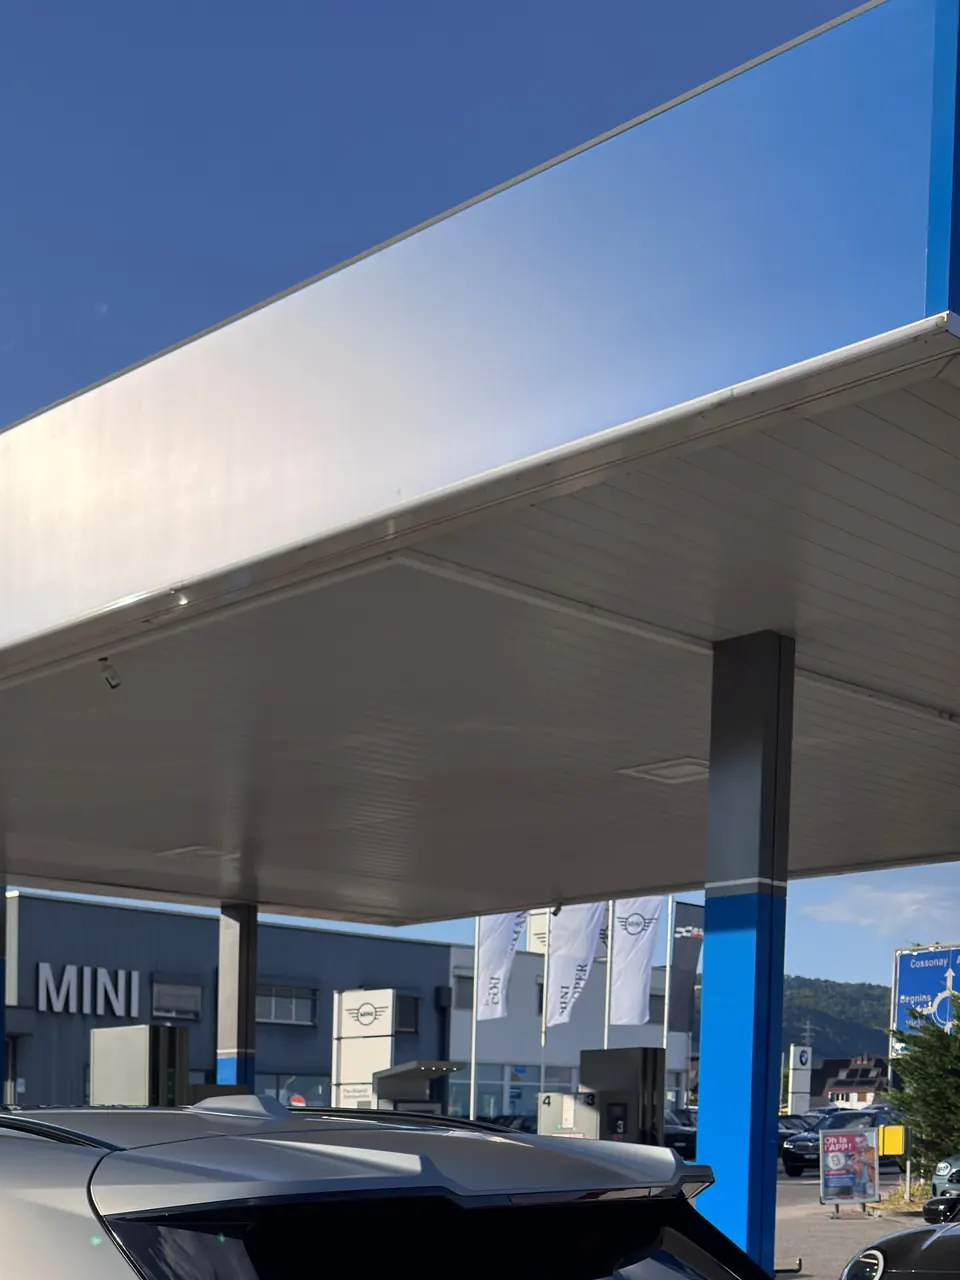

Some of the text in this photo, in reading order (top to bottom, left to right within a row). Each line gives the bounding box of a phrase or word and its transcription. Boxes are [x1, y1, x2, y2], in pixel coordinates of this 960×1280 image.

[910, 957, 948, 969] Cossonay
[38, 961, 139, 1018] MINI
[542, 1095, 551, 1107] 4
[587, 1094, 596, 1106] 3
[616, 1121, 624, 1133] 3
